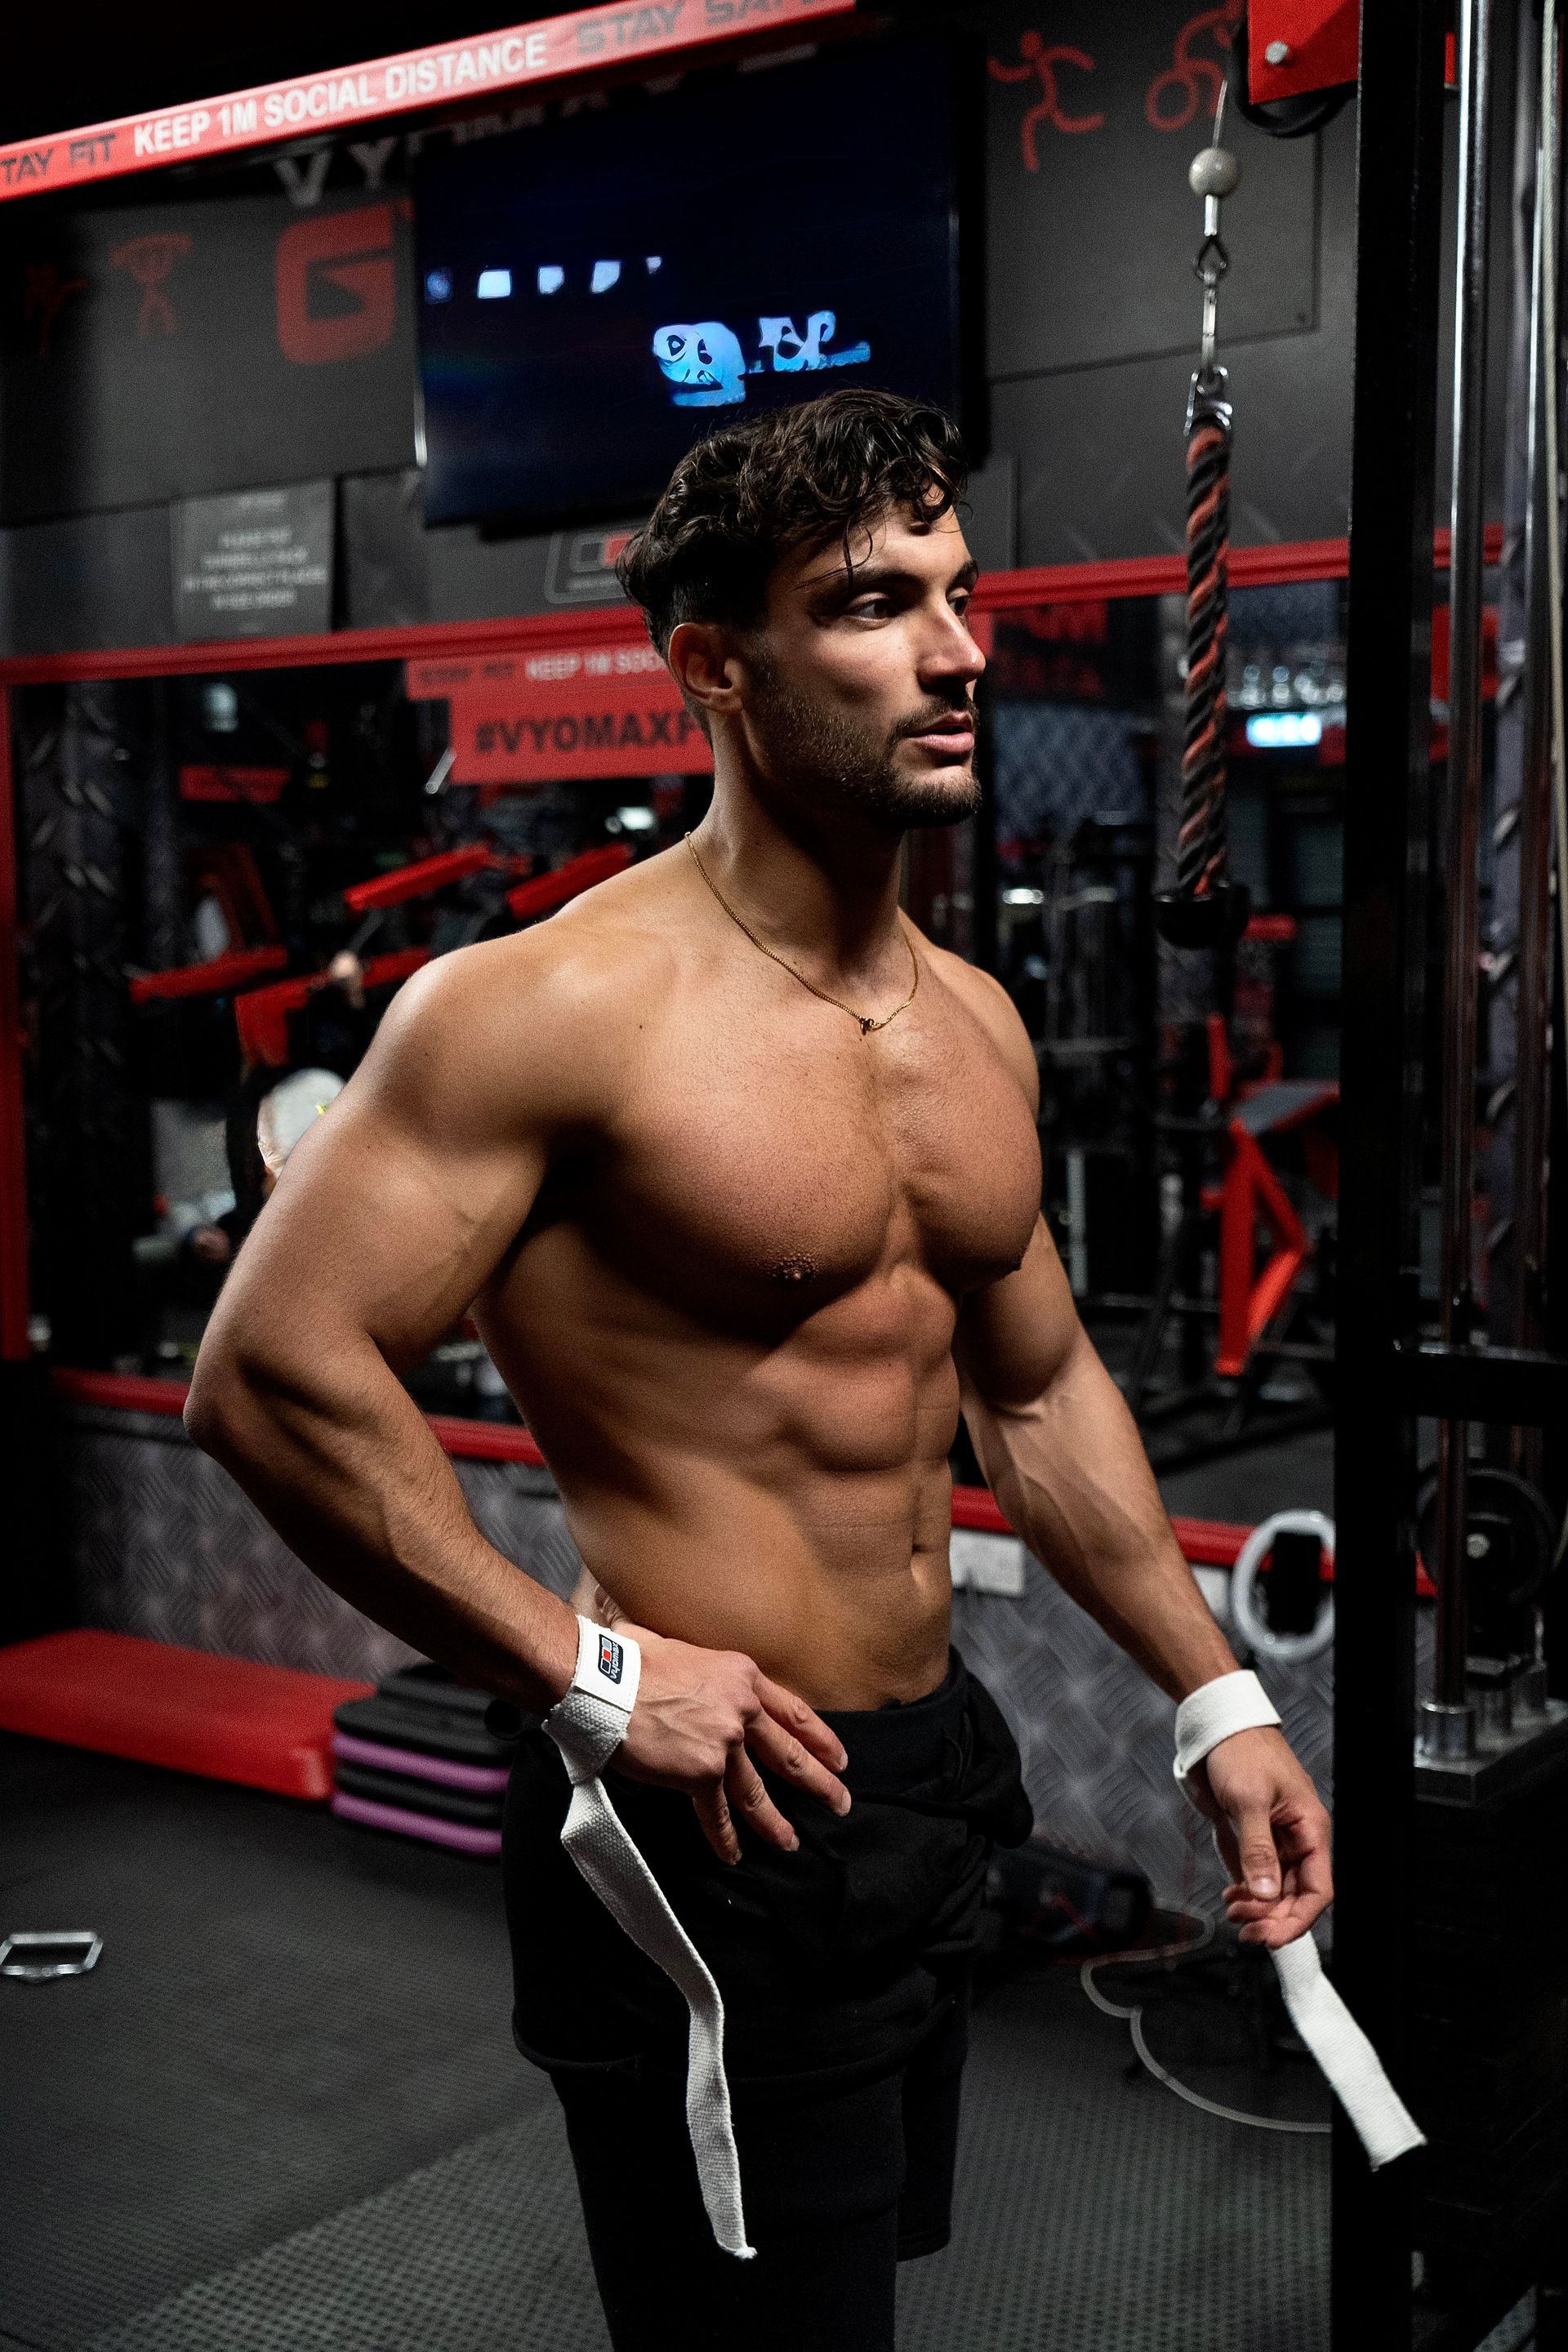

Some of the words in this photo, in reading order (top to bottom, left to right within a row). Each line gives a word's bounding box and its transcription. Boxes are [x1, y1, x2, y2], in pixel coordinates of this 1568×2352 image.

[0, 147, 54, 185] TAY
[68, 133, 117, 167] FIT
[134, 111, 211, 157] KEEP
[218, 100, 256, 136] 1M
[264, 76, 378, 127] SOCIAL
[384, 33, 547, 101] DISTANCE
[577, 0, 683, 54] STAY
